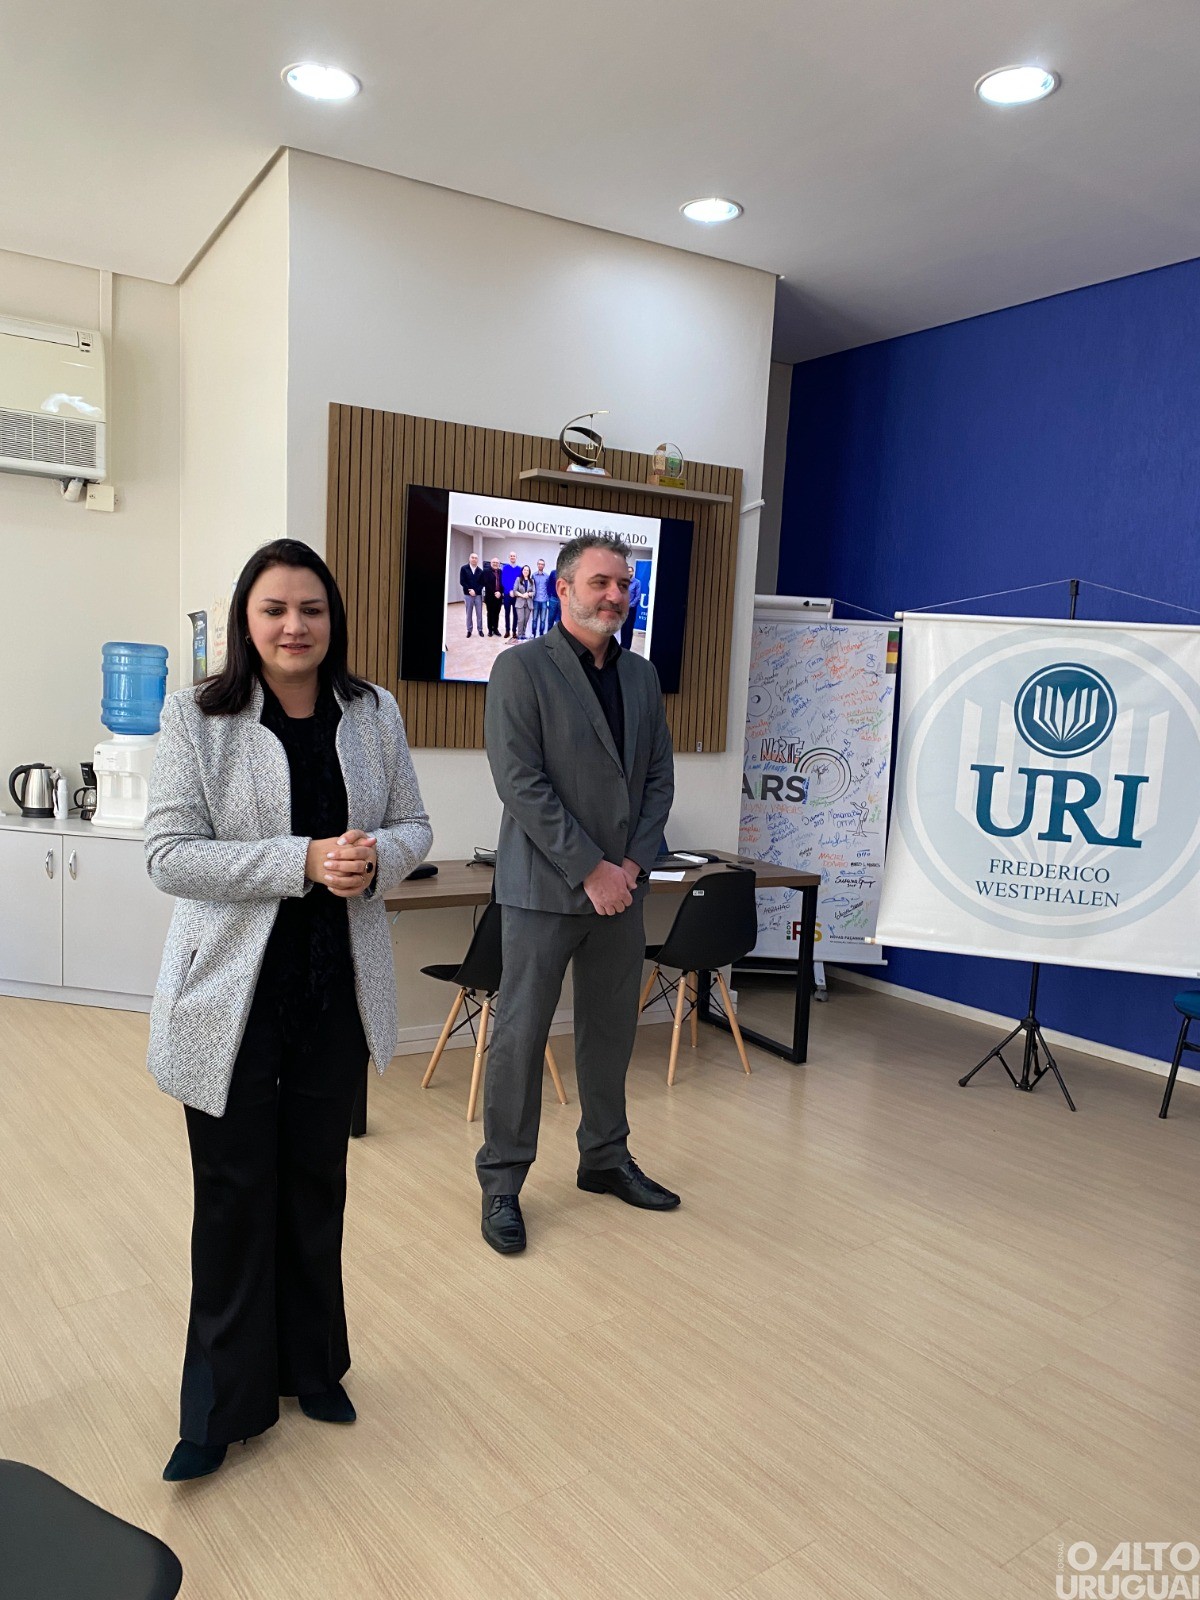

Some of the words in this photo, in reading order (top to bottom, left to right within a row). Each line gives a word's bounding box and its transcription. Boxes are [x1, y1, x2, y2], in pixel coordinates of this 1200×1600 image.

[474, 514, 515, 529] CORPO
[518, 520, 572, 536] DOCENTE
[970, 763, 1150, 849] URI
[988, 858, 1110, 884] FREDERICO
[975, 880, 1121, 908] WESTPHALEN
